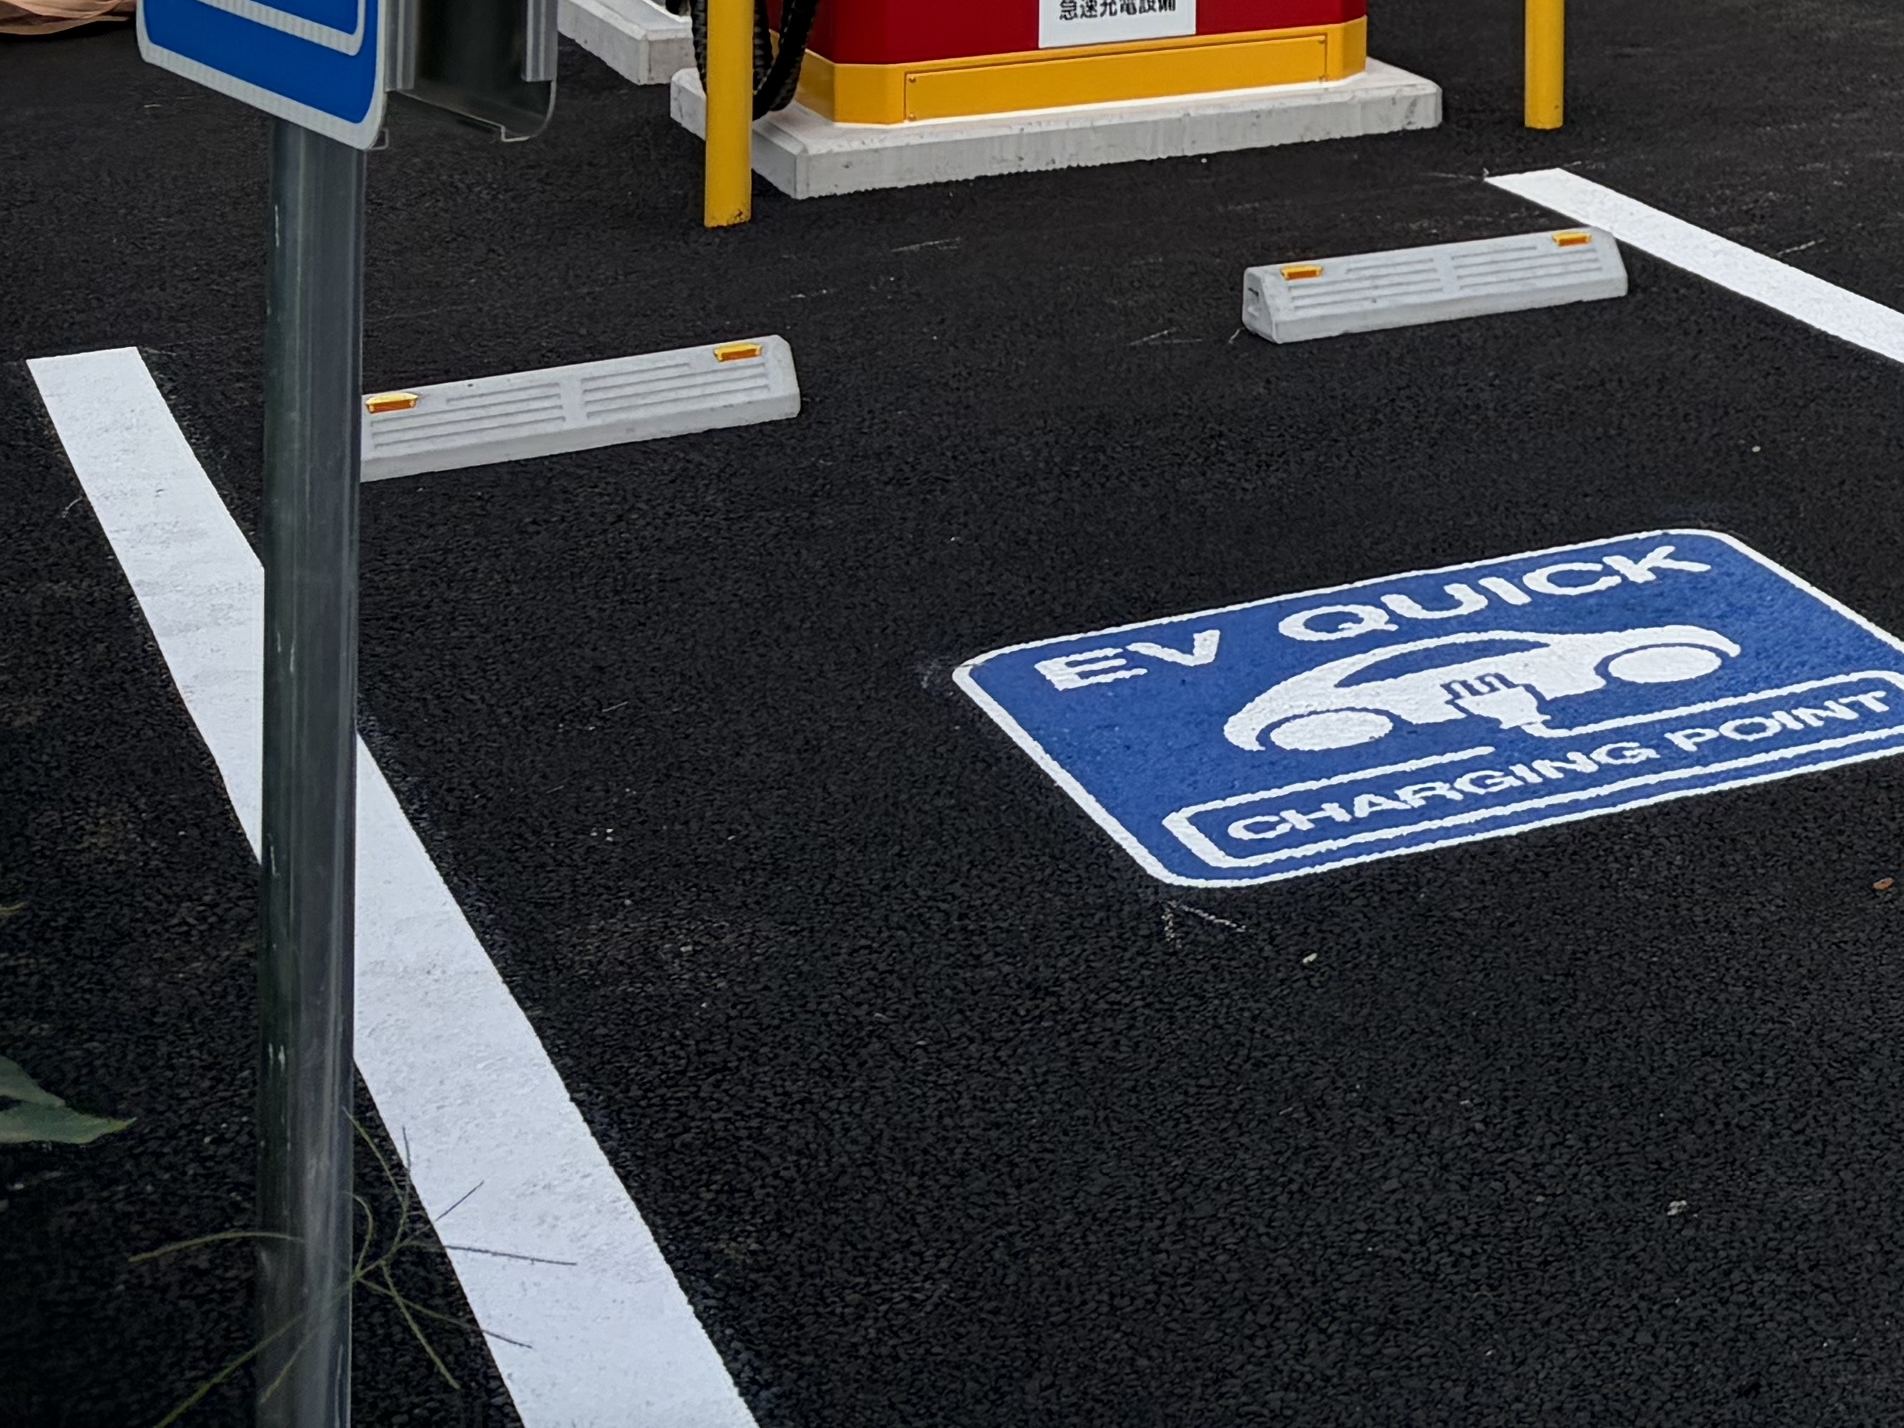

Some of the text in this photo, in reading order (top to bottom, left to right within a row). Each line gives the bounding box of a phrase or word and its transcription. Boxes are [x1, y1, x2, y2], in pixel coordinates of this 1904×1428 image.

[1031, 544, 1714, 694] EV QUICK
[1226, 690, 1889, 841] CHARGING POINT
